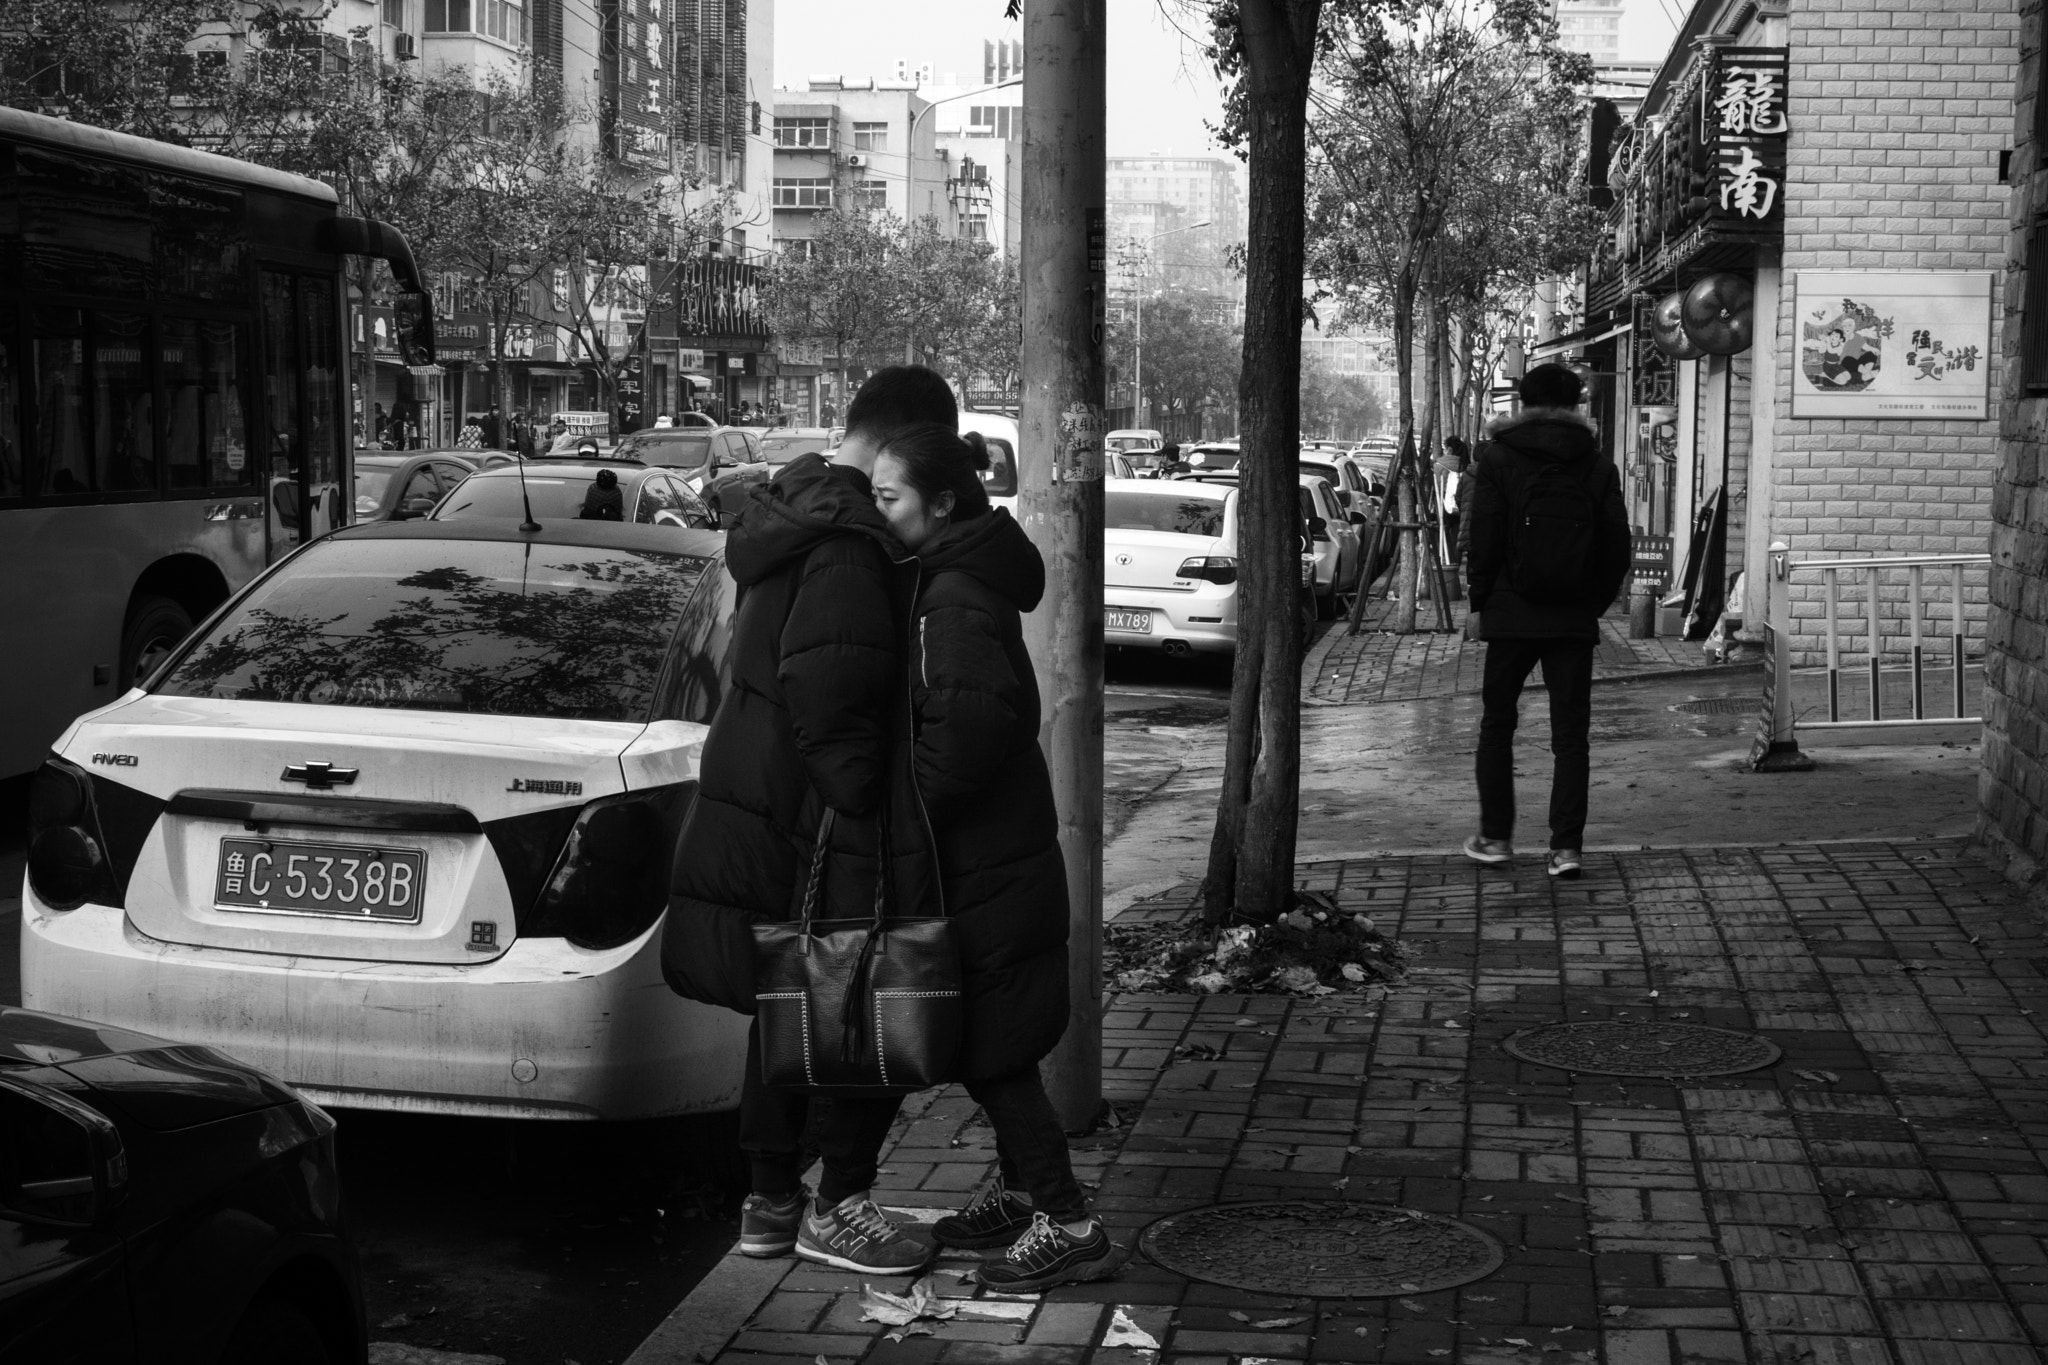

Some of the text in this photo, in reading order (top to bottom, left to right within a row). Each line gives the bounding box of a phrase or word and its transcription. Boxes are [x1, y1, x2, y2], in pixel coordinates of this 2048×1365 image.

[1714, 66, 1787, 220] 龍南
[1108, 612, 1149, 628] MX789
[92, 752, 138, 767] AVEO
[506, 777, 583, 796] 上海通用
